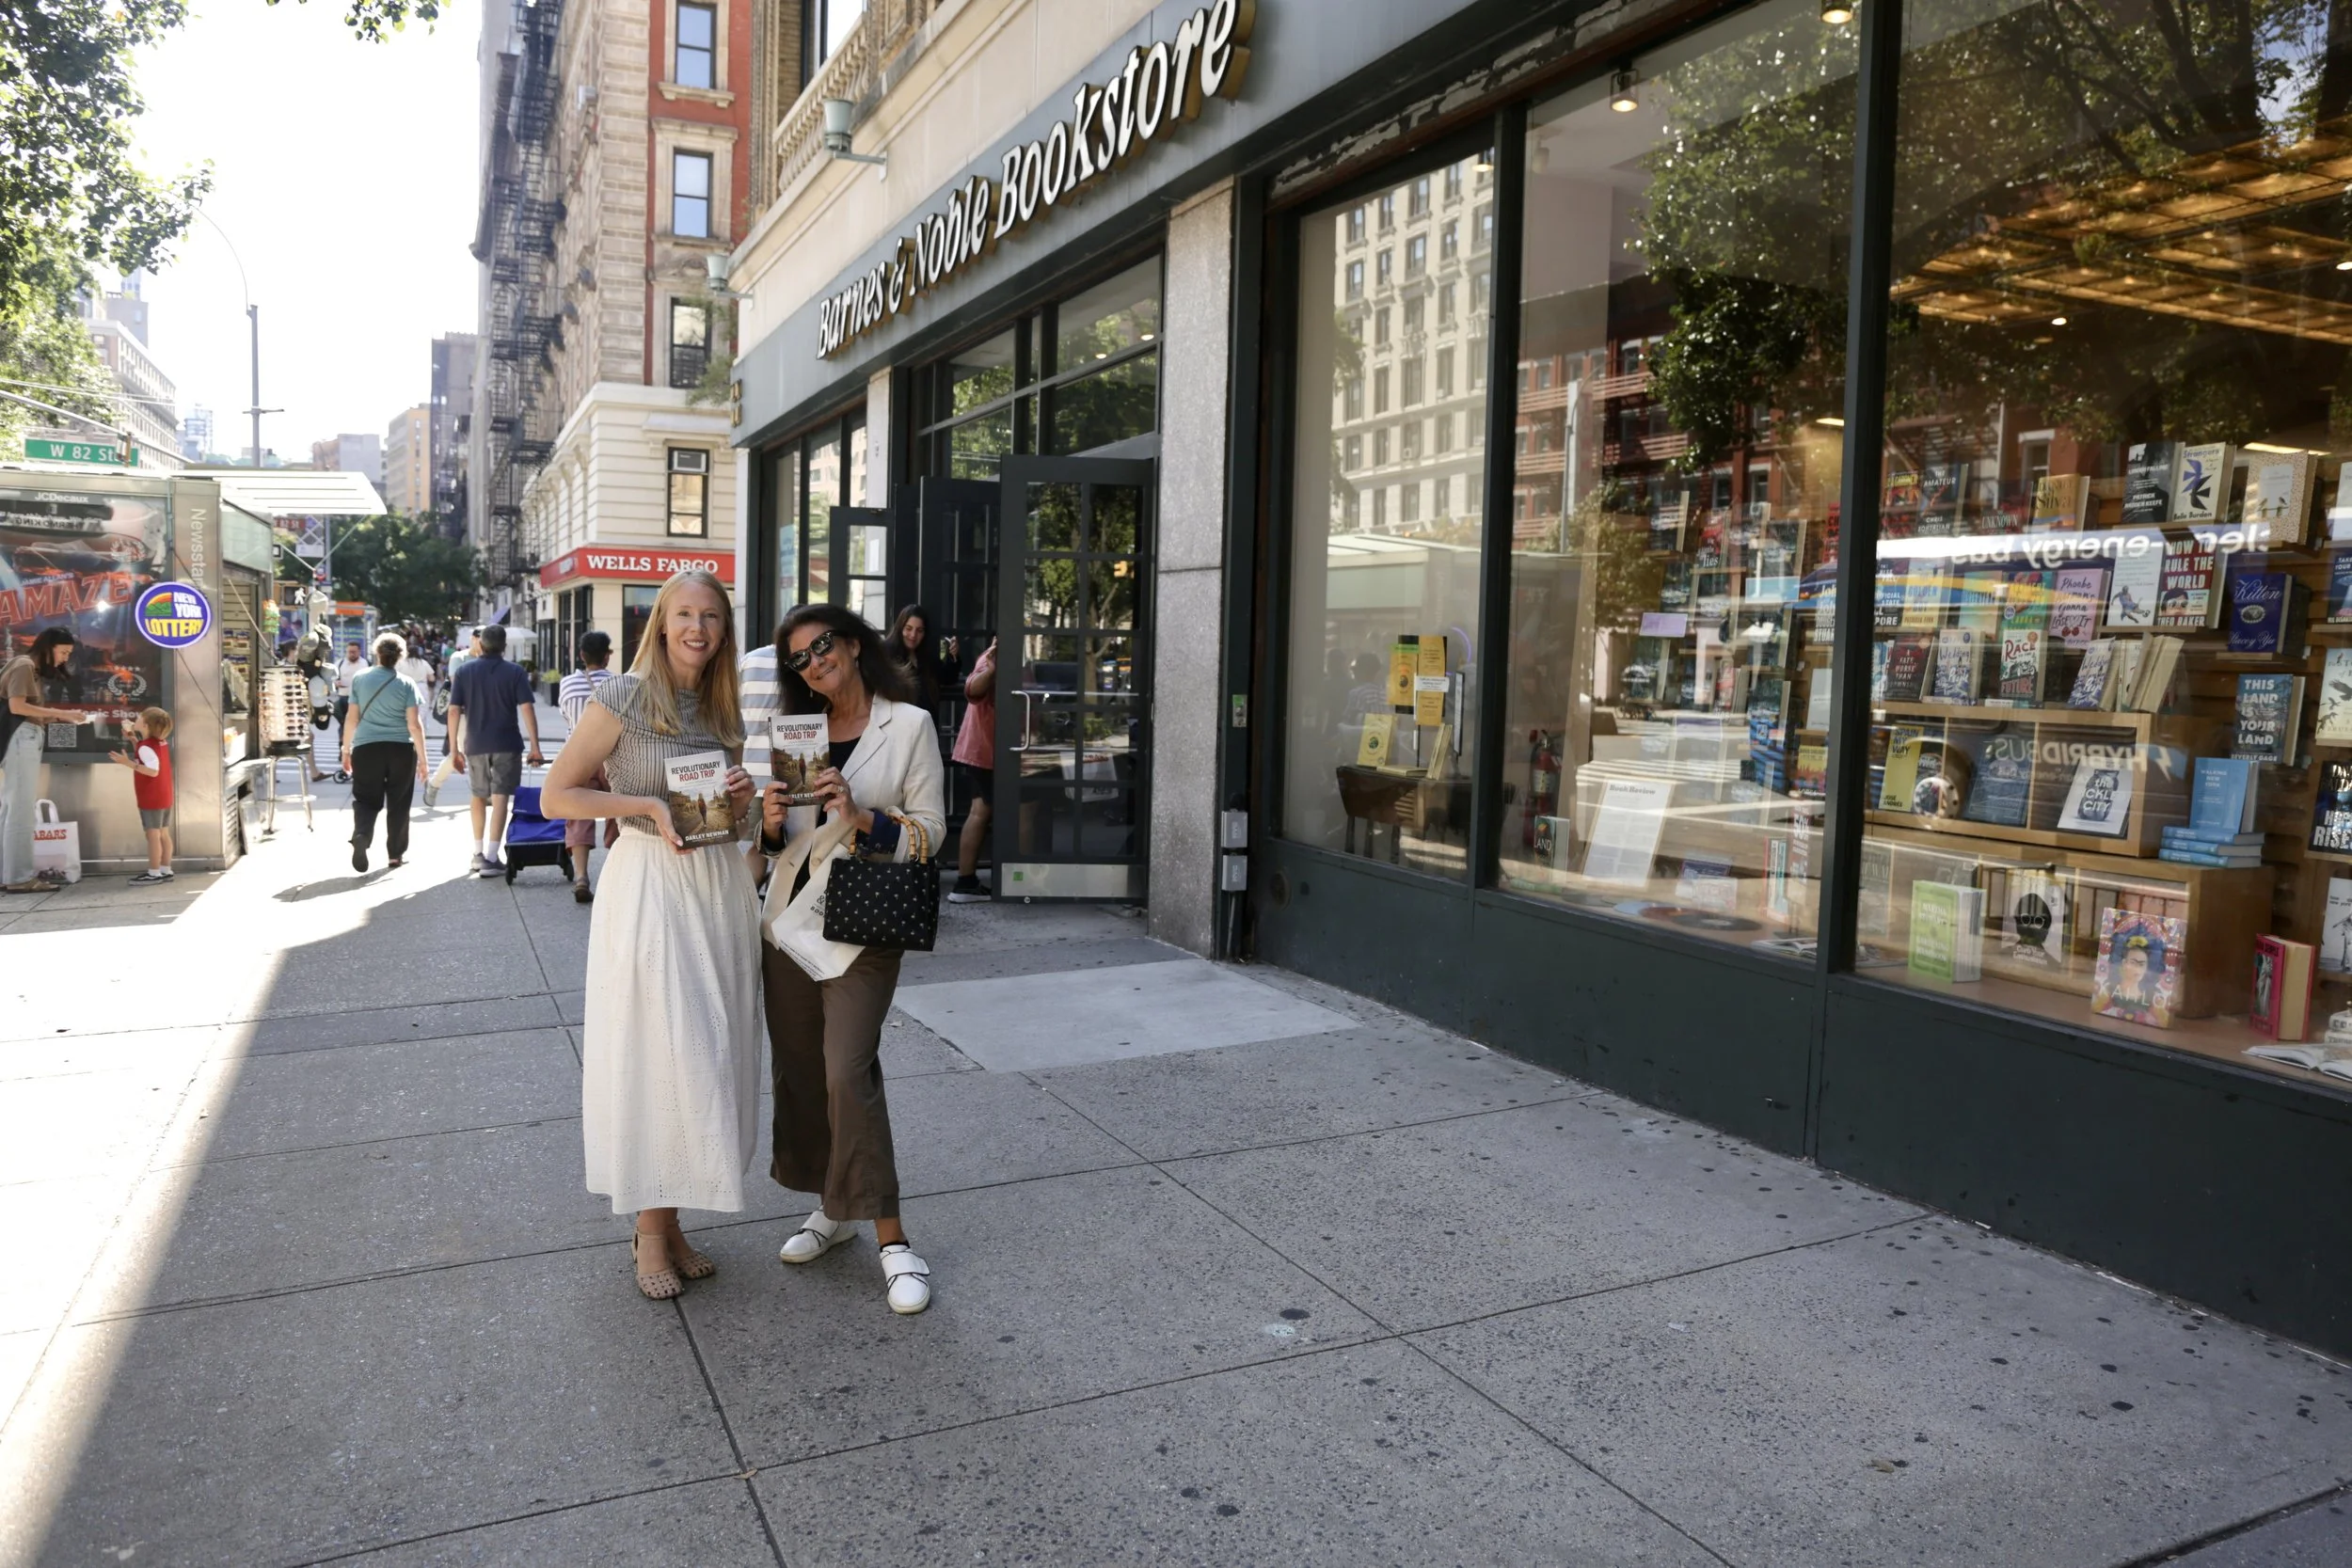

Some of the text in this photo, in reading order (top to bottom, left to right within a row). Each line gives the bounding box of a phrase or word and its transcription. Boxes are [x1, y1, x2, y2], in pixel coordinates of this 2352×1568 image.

[816, 0, 1239, 360] Barnes & Noble Bookstore
[50, 444, 66, 458] W
[72, 446, 91, 460] 82
[2183, 449, 2219, 459] Strangers
[1923, 477, 1957, 488] AMATEUR
[34, 492, 88, 503] JCDecaux
[586, 555, 651, 572] WELLS
[657, 558, 719, 574] FARGO
[2164, 558, 2190, 573] RULE
[2194, 556, 2214, 571] THE
[2060, 577, 2092, 590] Phoebe
[2167, 575, 2205, 590] WORLD
[1820, 583, 1836, 598] Joh
[2234, 579, 2282, 601] Kitten
[0, 575, 132, 626] AMAZE
[173, 592, 197, 604] NEW
[174, 603, 202, 618] YORK
[1874, 616, 1899, 626] PORE
[2177, 616, 2205, 626] BAKER
[144, 618, 204, 638] LOTTERY
[1813, 628, 1835, 641] STUAR
[2005, 640, 2036, 662] RACE
[2245, 679, 2275, 690] THIS
[2242, 693, 2278, 705] LAND
[2241, 706, 2254, 717] IS
[776, 722, 823, 733] REVOLUTIONARY
[2240, 721, 2275, 732] YOUR
[803, 731, 818, 739] TRIP
[2238, 734, 2274, 745] LAND
[1892, 746, 1911, 754] WAY
[671, 761, 721, 775] REVOLUTIONARY
[679, 769, 716, 783] ROAD TRIP
[2083, 800, 2110, 813] CITY
[33, 829, 68, 841] ABARS
[685, 830, 729, 842] DARLEY NEWMAN
[2313, 826, 2352, 850] RISE
[1534, 838, 1551, 850] LAND
[817, 895, 825, 905] &
[810, 906, 824, 917] BOO
